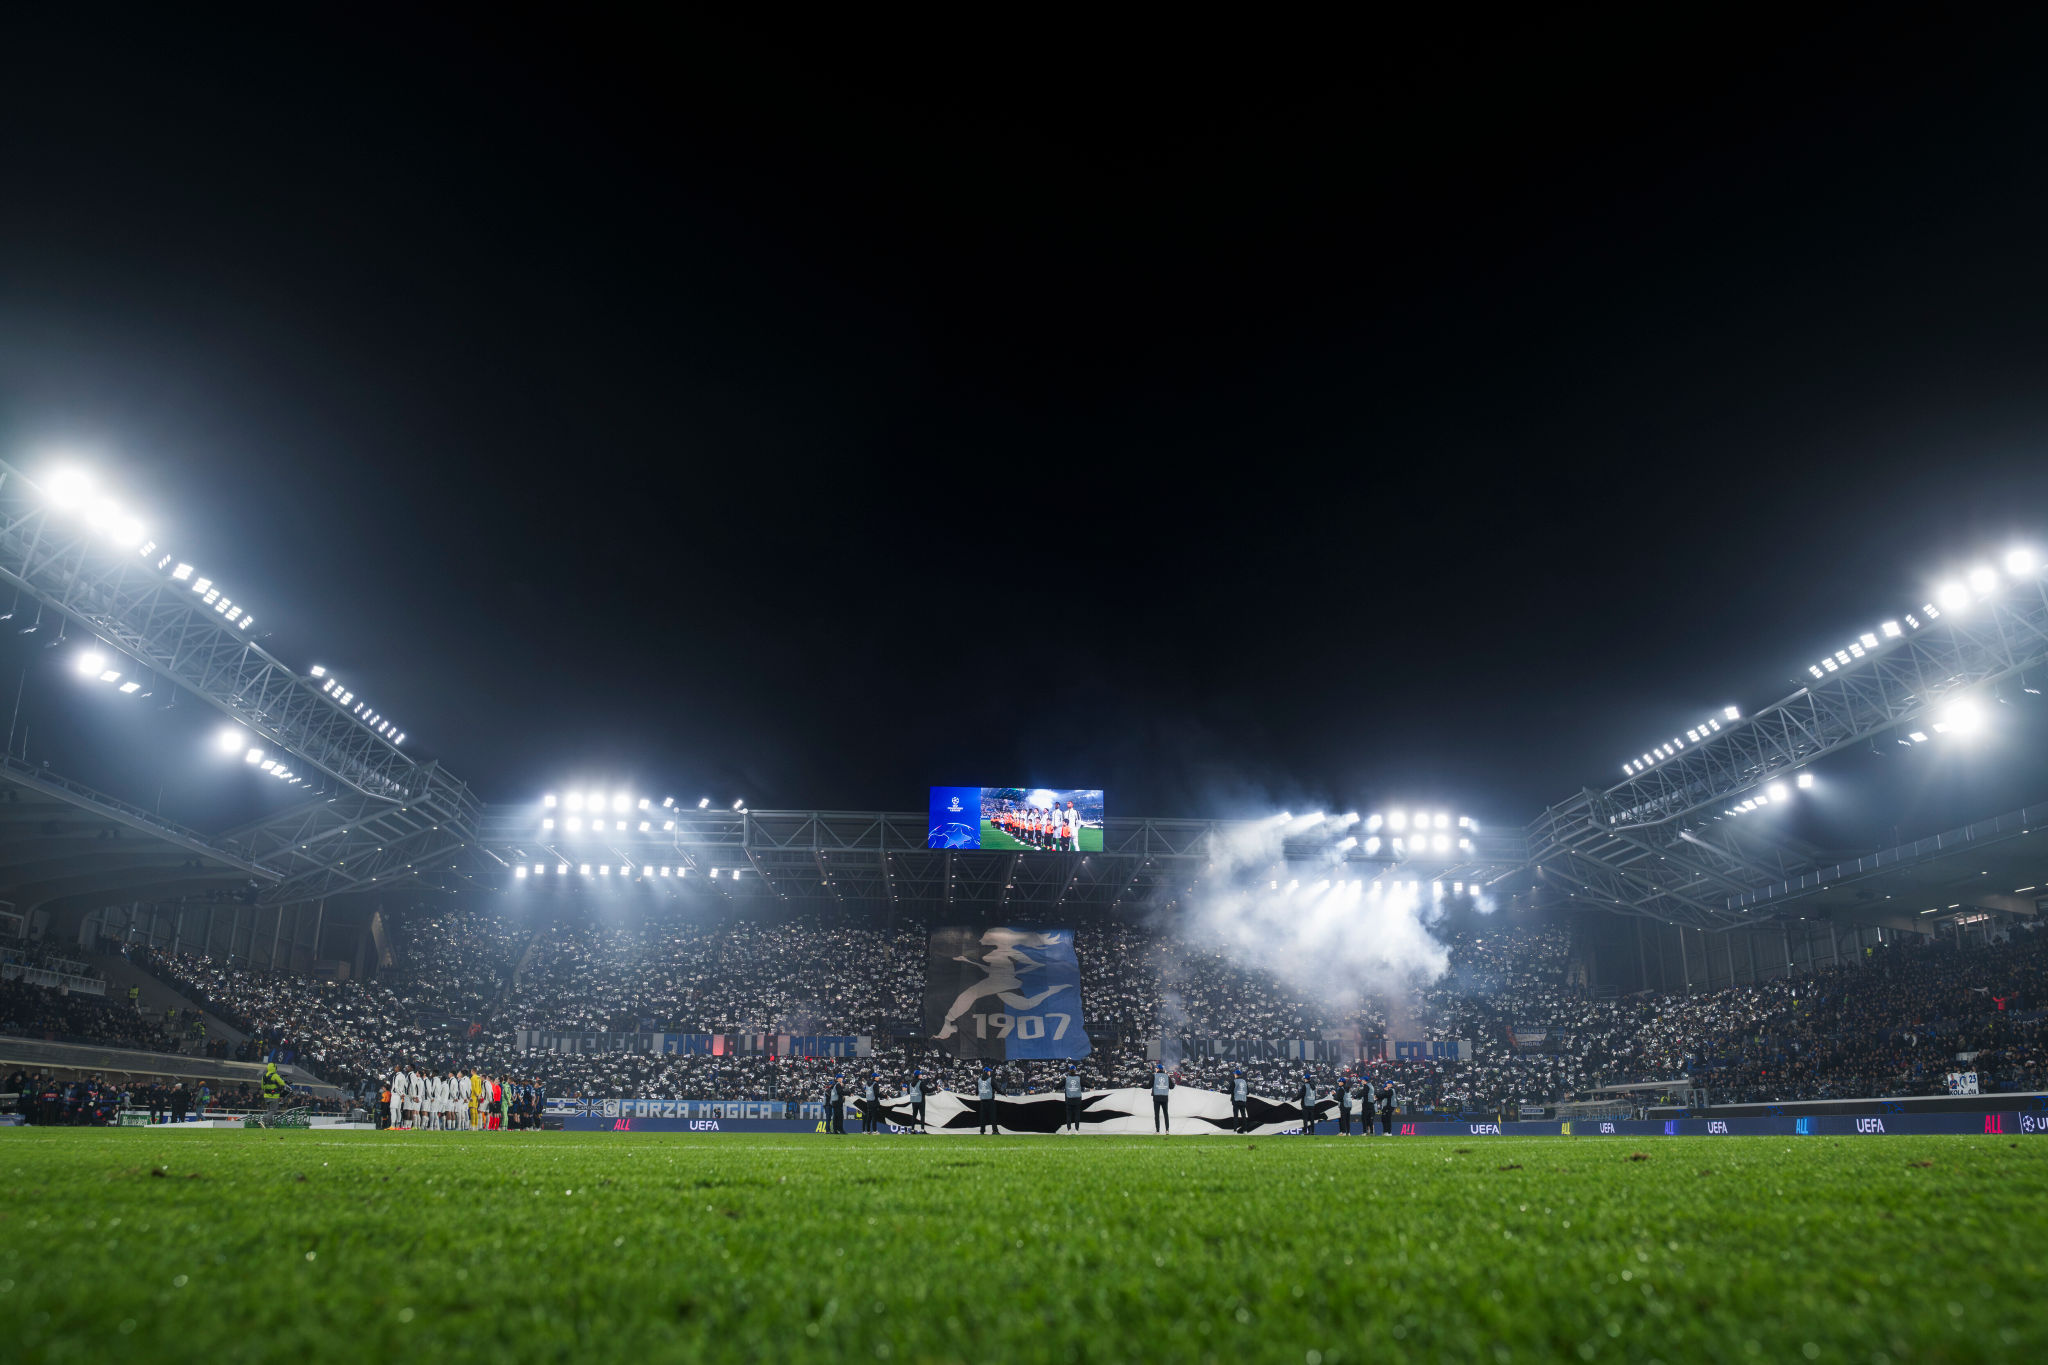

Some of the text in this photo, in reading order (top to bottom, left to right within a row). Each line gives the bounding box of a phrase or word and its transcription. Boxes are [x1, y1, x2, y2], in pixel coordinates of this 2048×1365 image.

[972, 1013, 1071, 1040] 1907
[527, 1031, 857, 1057] LOTTEREMO FINO ALLA MORTE
[1968, 1074, 1977, 1084] 23
[622, 1102, 689, 1118] FORZA
[698, 1103, 772, 1119] MAGICA
[613, 1118, 631, 1131] ALL
[689, 1120, 719, 1131] UEFA
[815, 1121, 834, 1133] AL
[1400, 1123, 1416, 1135] ALL
[1470, 1124, 1500, 1135] UEFA
[1561, 1122, 1571, 1135] ALL
[1599, 1122, 1615, 1134] UEFA
[1664, 1121, 1675, 1135] ALL
[1707, 1121, 1728, 1134] UEFA
[1795, 1118, 1808, 1135] ALL
[1856, 1118, 1885, 1133] UEFA
[1984, 1114, 2003, 1134] ALL
